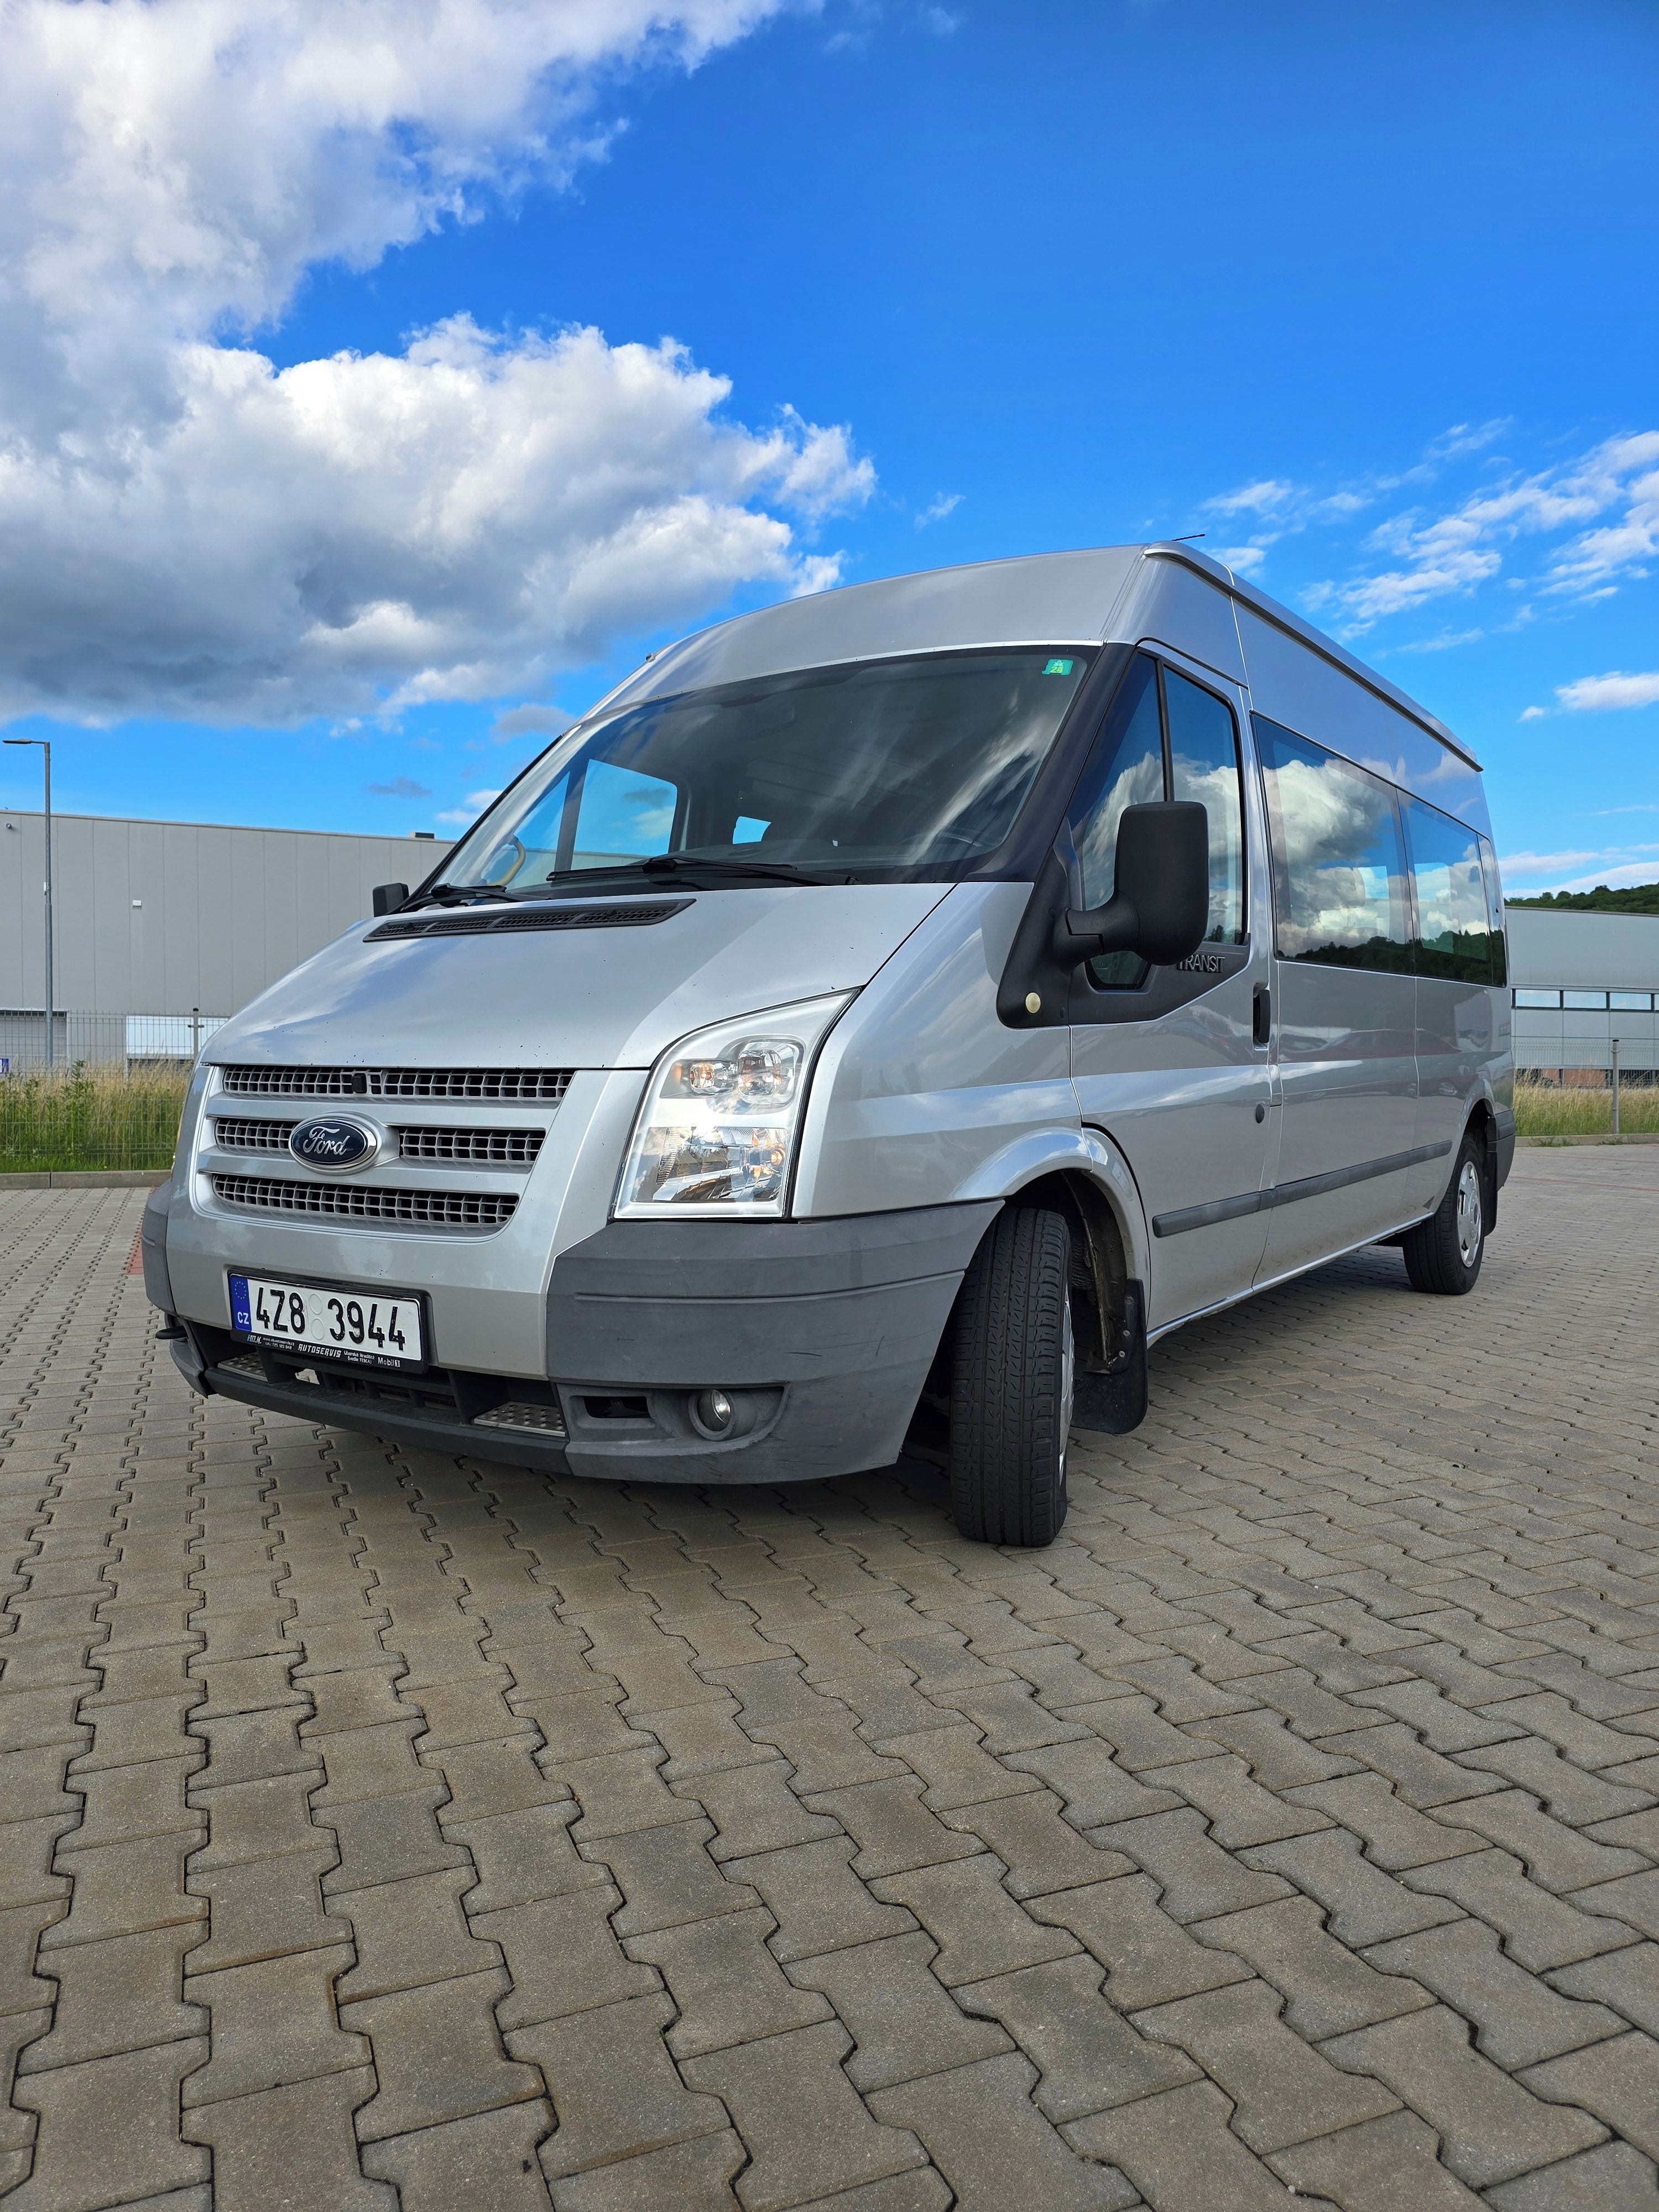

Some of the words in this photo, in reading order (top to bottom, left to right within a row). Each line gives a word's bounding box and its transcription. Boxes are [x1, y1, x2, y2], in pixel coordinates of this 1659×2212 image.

[303, 1126, 350, 1155] Ford
[238, 1311, 249, 1324] CZ
[256, 1287, 305, 1334] 4Z8
[327, 1298, 406, 1352] 3944
[298, 1343, 342, 1358] AUTOSERVIS
